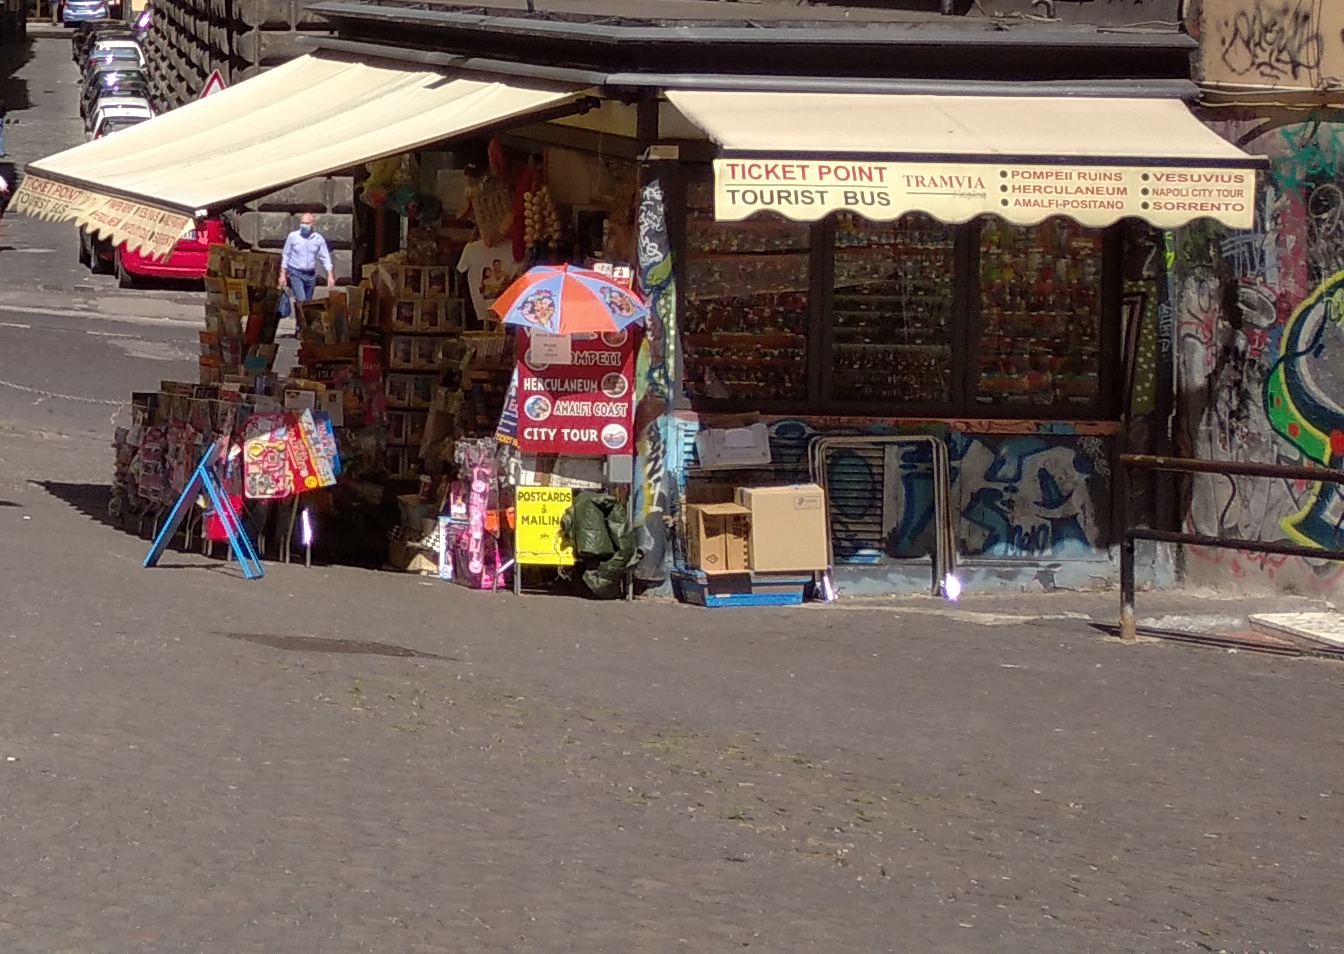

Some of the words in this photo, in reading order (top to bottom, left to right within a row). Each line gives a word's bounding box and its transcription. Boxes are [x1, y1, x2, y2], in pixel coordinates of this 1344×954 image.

[725, 163, 810, 181] TICKET
[818, 164, 888, 183] POINT
[1011, 170, 1073, 182] POMPEII
[1077, 171, 1123, 182] RUINS
[1152, 173, 1245, 184] VESUVIUS
[23, 176, 53, 193] TICKET
[902, 174, 986, 190] TRAMVIA
[1012, 184, 1128, 196] HERCULANEUM
[1152, 187, 1189, 198] NAPOLI
[1191, 188, 1214, 198] CITY
[1217, 188, 1244, 198] TOUR
[725, 189, 829, 206] TOURIST
[844, 190, 891, 207] BUS
[1013, 198, 1125, 210] AMALFI-POSITANO
[1152, 201, 1245, 212] SORRENTO
[570, 351, 622, 366] OMPEII
[524, 377, 598, 392] HERCULANEUM
[554, 401, 592, 416] AMALFI
[593, 402, 628, 417] COAST
[524, 428, 558, 441] CITY
[561, 428, 598, 442] TOUR
[517, 492, 572, 502] POSTCARDS
[520, 515, 560, 526] MAILIN
